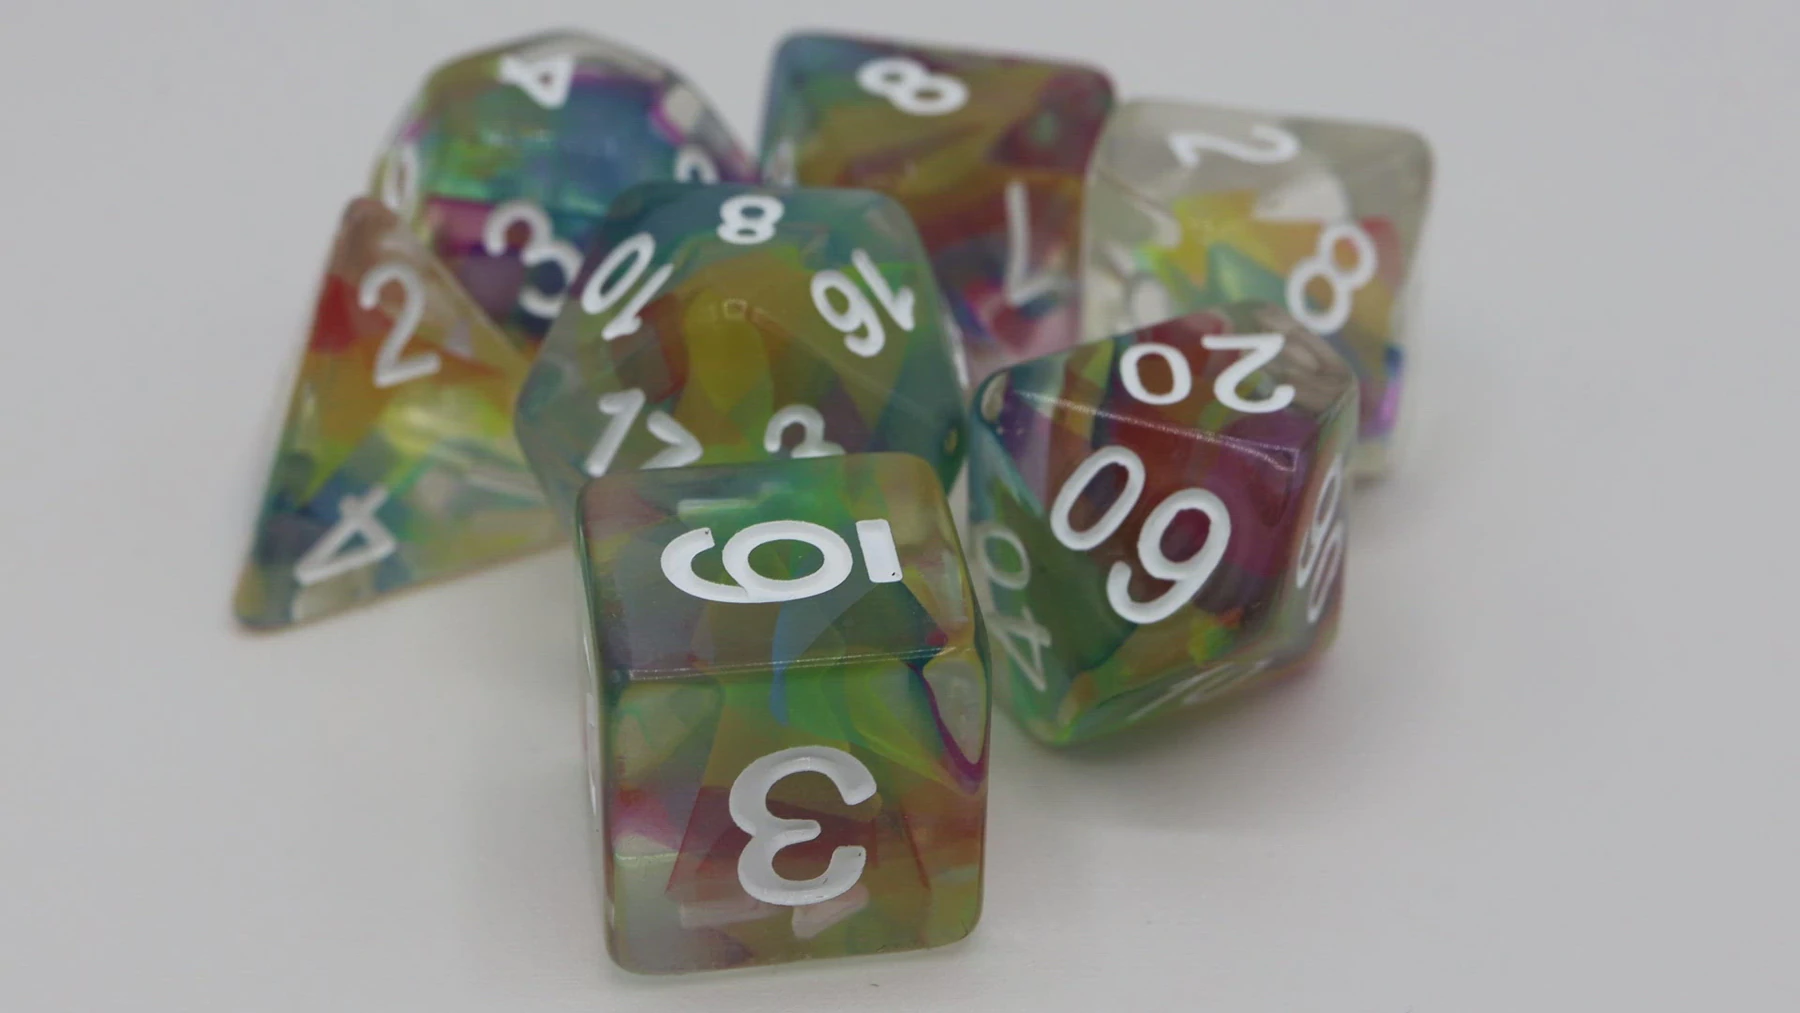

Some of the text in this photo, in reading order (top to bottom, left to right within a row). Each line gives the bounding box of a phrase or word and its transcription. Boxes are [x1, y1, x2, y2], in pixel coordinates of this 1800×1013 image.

[498, 54, 574, 109] 4
[857, 56, 967, 116] 8
[1168, 123, 1300, 168] 2
[483, 202, 584, 319] 3
[717, 194, 785, 245] 8
[359, 262, 442, 389] 2
[581, 232, 680, 341] 10
[810, 249, 915, 357] 16
[1284, 221, 1377, 335] 8
[1119, 332, 1296, 413] 20
[294, 486, 396, 587] 4
[1050, 444, 1231, 625] 60
[729, 745, 877, 906] 3
